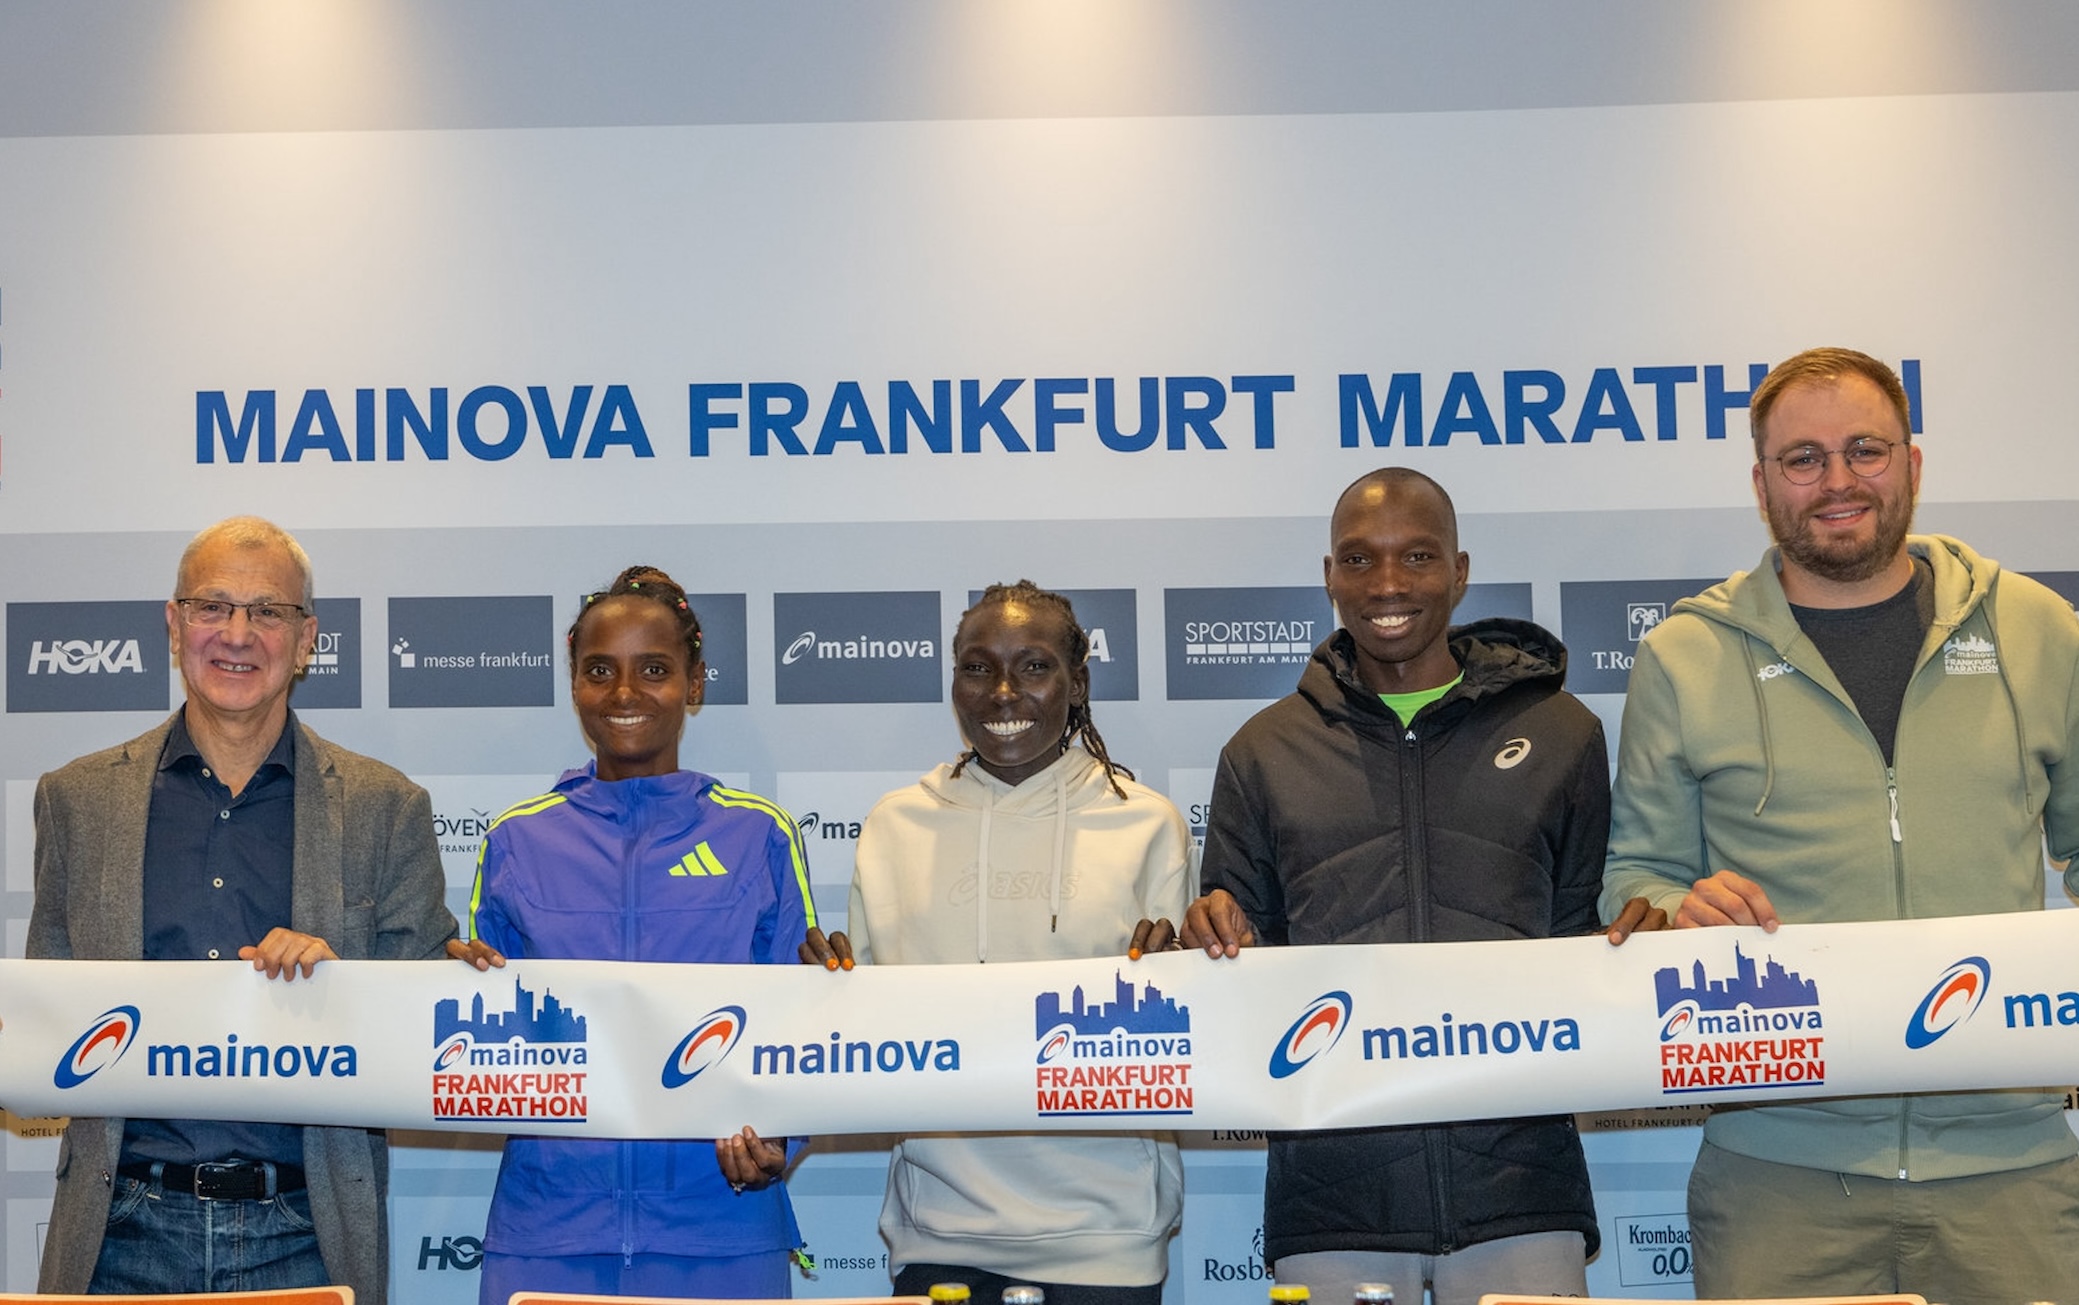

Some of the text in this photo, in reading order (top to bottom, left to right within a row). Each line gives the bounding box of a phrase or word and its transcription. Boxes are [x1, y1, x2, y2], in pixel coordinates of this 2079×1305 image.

[196, 359, 1924, 464] MAINOVA FRANKFURT MARATH
[1185, 621, 1315, 643] SPORTSTADT
[28, 640, 142, 675] HOKA
[817, 635, 934, 659] mainova
[308, 667, 339, 675] MAIN
[423, 652, 550, 668] messe frankfurt
[1186, 656, 1253, 665] FRANKFURT
[1259, 656, 1276, 664] AM
[433, 814, 496, 836] ÖVEN
[1697, 1009, 1823, 1035] mainova
[1074, 1033, 1191, 1058] mainova
[1363, 1013, 1581, 1061] mainova
[148, 1034, 357, 1077] mainova
[470, 1036, 587, 1066] mainova
[753, 1031, 960, 1075] mainova
[1661, 1037, 1824, 1066] FRANKFURT
[434, 1073, 587, 1095] FRANKFURT
[1037, 1064, 1191, 1088] FRANKFURT
[1662, 1060, 1825, 1088] MARATHON
[434, 1096, 587, 1117] MARATHON
[1038, 1087, 1193, 1111] MARATHON
[21, 1128, 52, 1137] HOTEL
[1595, 1119, 1628, 1128] HOTEL
[1632, 1118, 1693, 1127] FRANKFURT
[824, 1257, 876, 1270] messe
